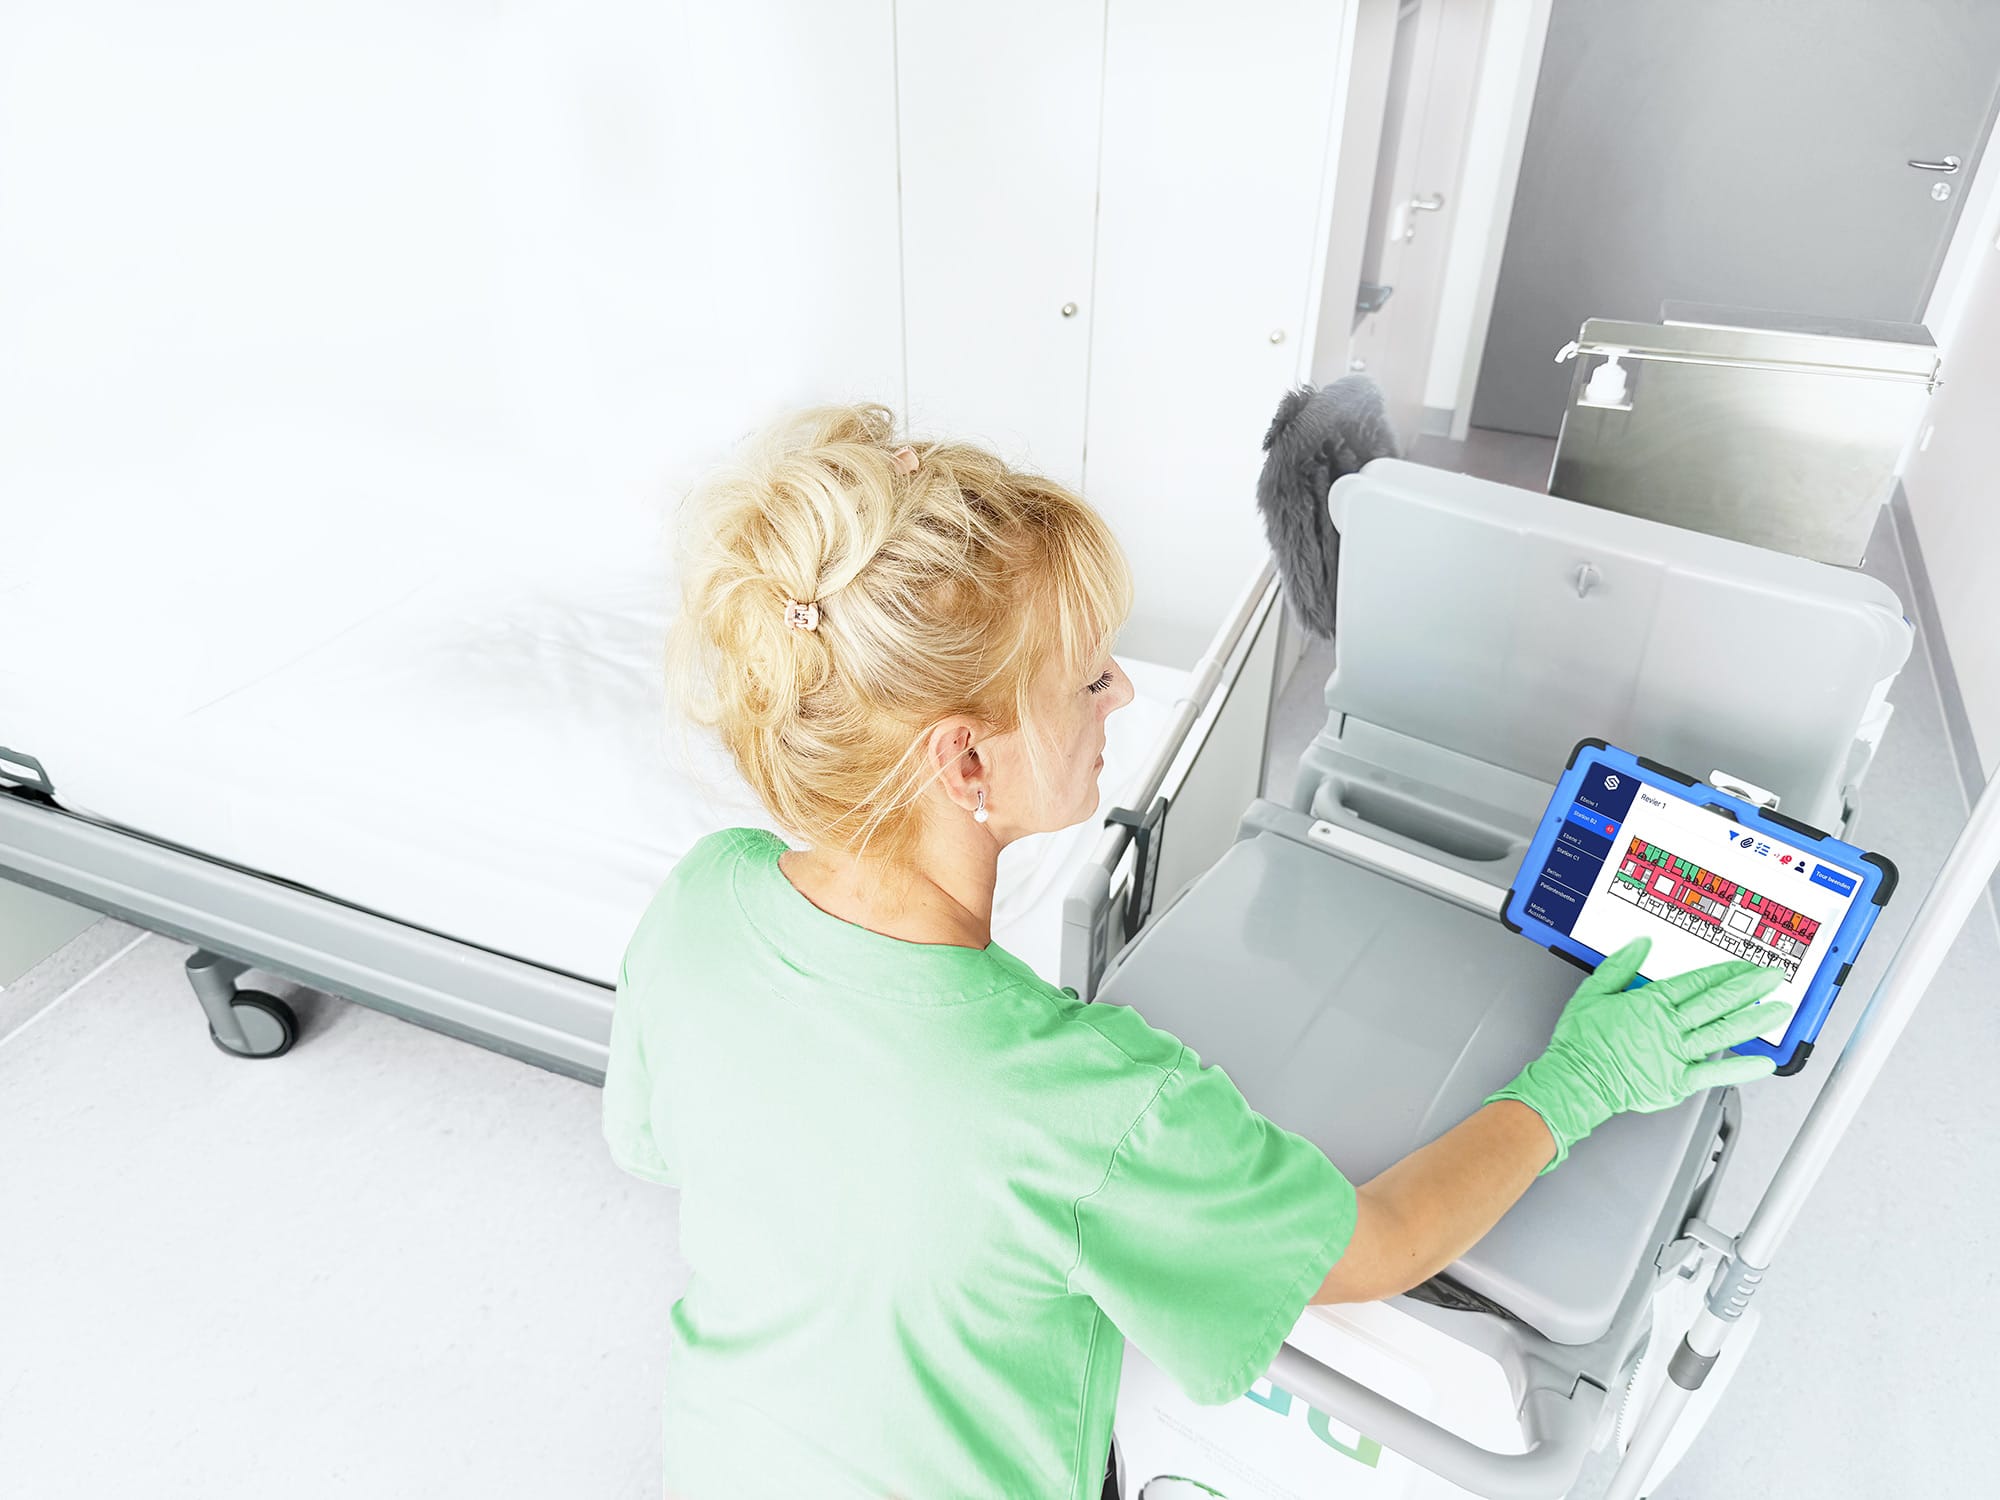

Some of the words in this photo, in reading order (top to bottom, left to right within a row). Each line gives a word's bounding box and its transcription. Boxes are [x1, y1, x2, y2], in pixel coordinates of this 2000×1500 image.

[1580, 795, 1595, 807] Ebene
[1641, 793, 1661, 807] Revier
[1573, 810, 1590, 822] Station
[1590, 817, 1598, 825] B2
[1562, 832, 1578, 843] Ebene
[1556, 846, 1573, 858] Station
[1816, 870, 1828, 880] Tour
[1828, 876, 1851, 890] beenden
[1540, 881, 1576, 903] Patientenbetten
[1530, 902, 1546, 914] Mobile
[1528, 908, 1554, 926] Ausstattung
